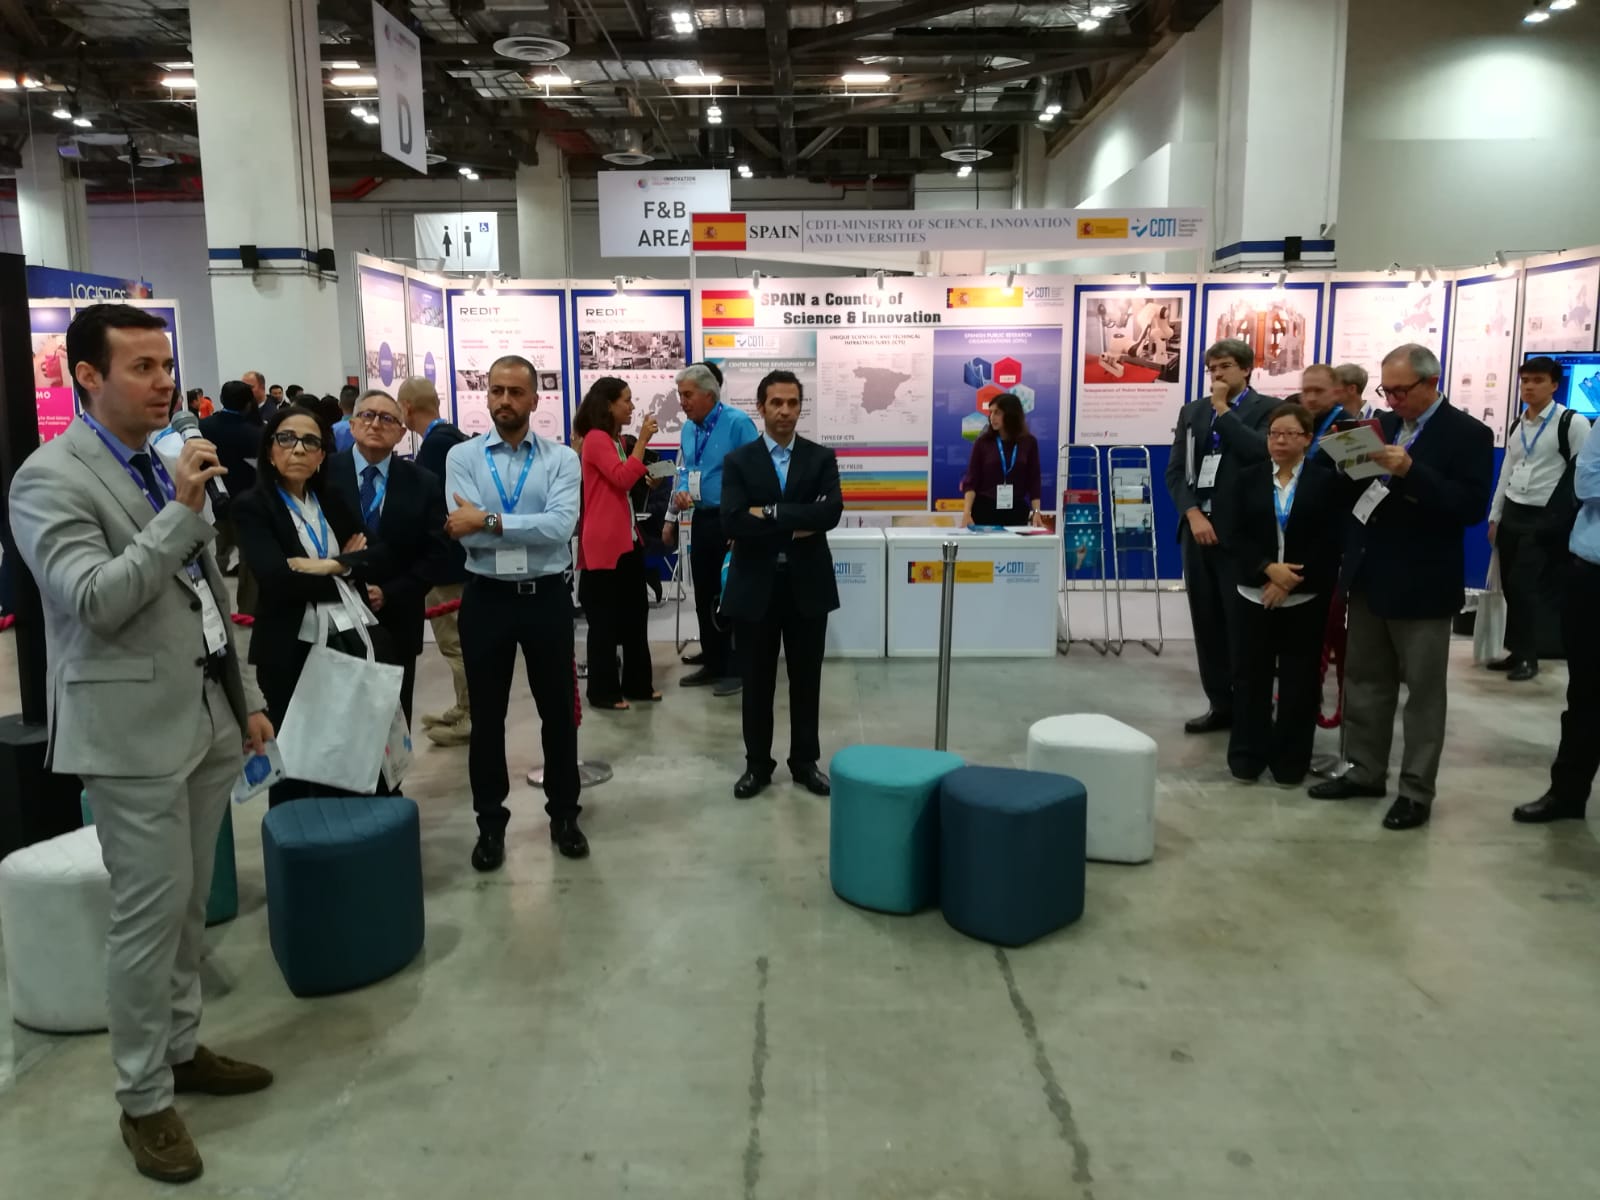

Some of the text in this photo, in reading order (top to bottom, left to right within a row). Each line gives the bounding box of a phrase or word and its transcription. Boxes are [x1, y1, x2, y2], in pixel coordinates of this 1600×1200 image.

[398, 93, 412, 154] D
[644, 201, 686, 218] F&B
[806, 217, 1072, 231] CDTI-MINISTRY OF SCIENCE, INNOVATION
[1149, 217, 1176, 237] CDTI
[638, 230, 690, 246] AREA
[749, 225, 800, 239] SPAIN
[805, 232, 926, 244] AND UNIVERSITIES
[70, 283, 126, 300] LOGISTICS
[1034, 287, 1050, 298] CDTI
[760, 292, 904, 308] SPAIN a Country of
[460, 307, 501, 315] REDIT
[585, 308, 627, 316] REDIT
[783, 310, 941, 325] Science & Innovation
[747, 335, 764, 347] CDTI
[1006, 561, 1024, 574] CDTI
